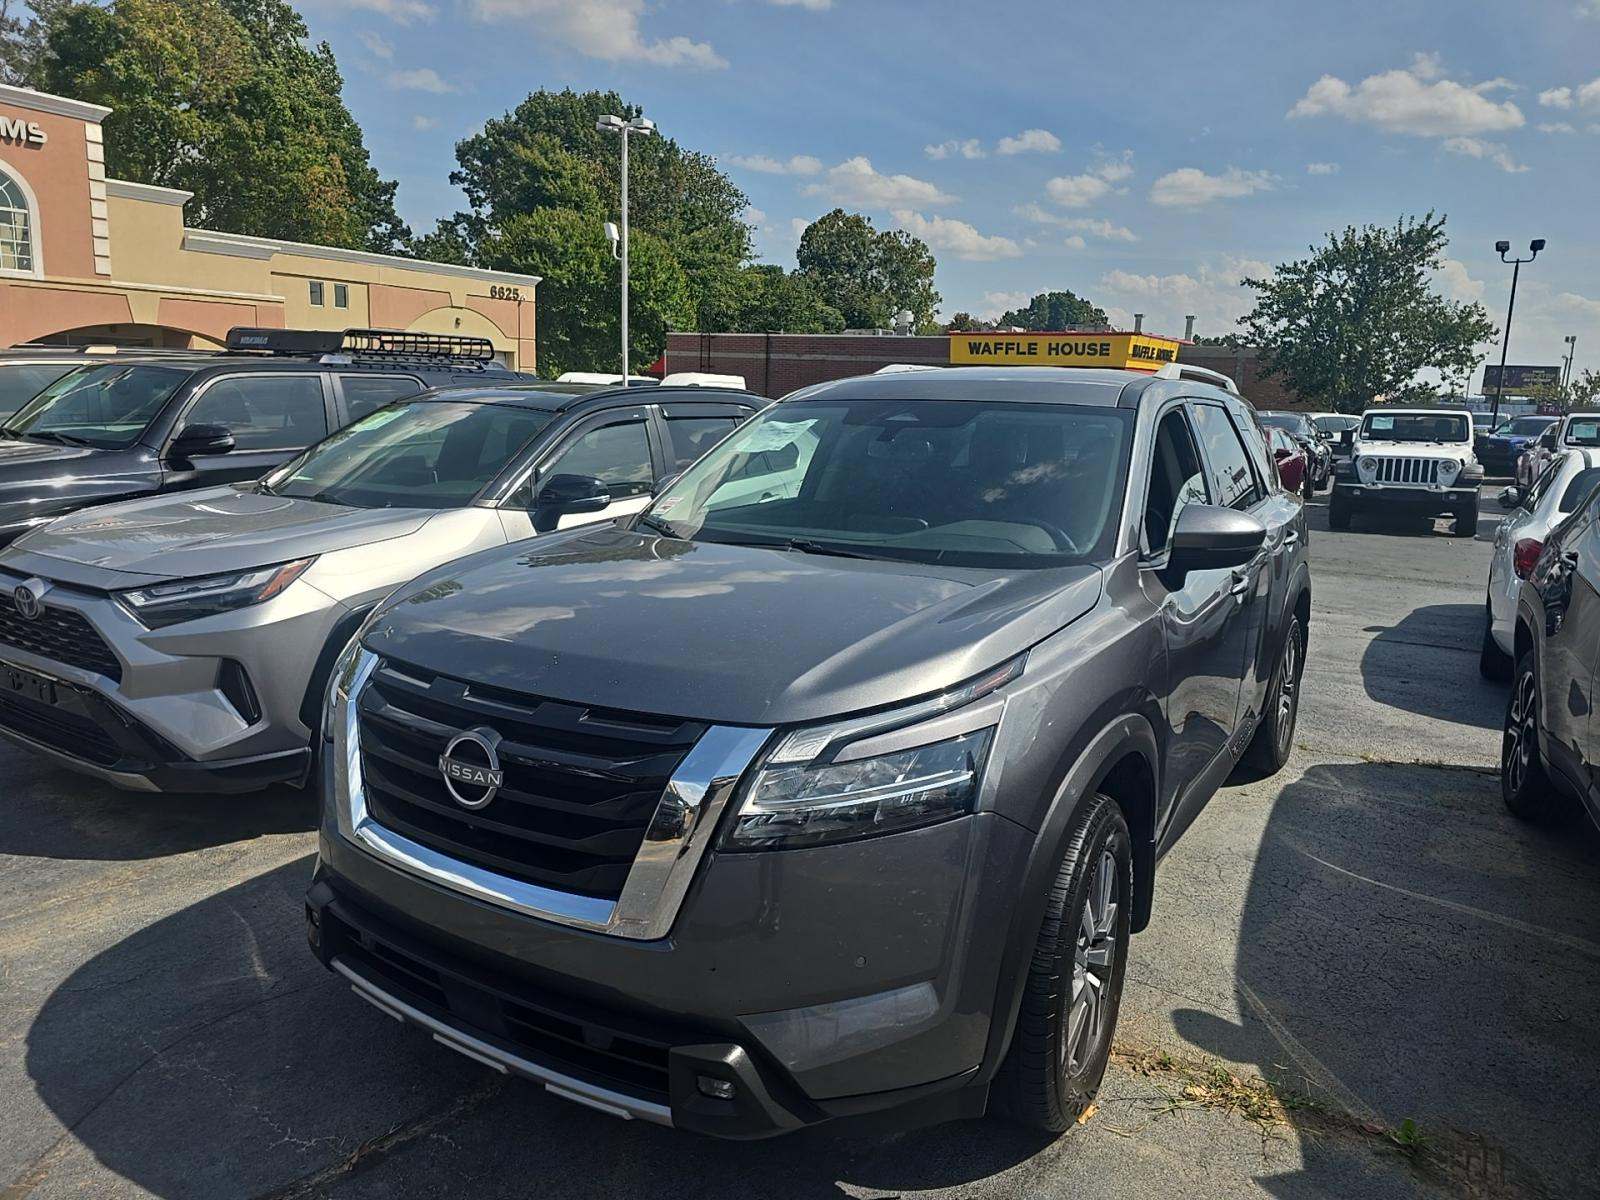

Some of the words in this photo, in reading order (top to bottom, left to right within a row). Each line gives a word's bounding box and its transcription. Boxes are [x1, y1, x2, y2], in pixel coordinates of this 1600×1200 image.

[490, 285, 520, 301] 6625
[967, 342, 1038, 356] WAFFLE
[1047, 342, 1111, 357] HOUSE
[439, 757, 501, 785] NISSAN
